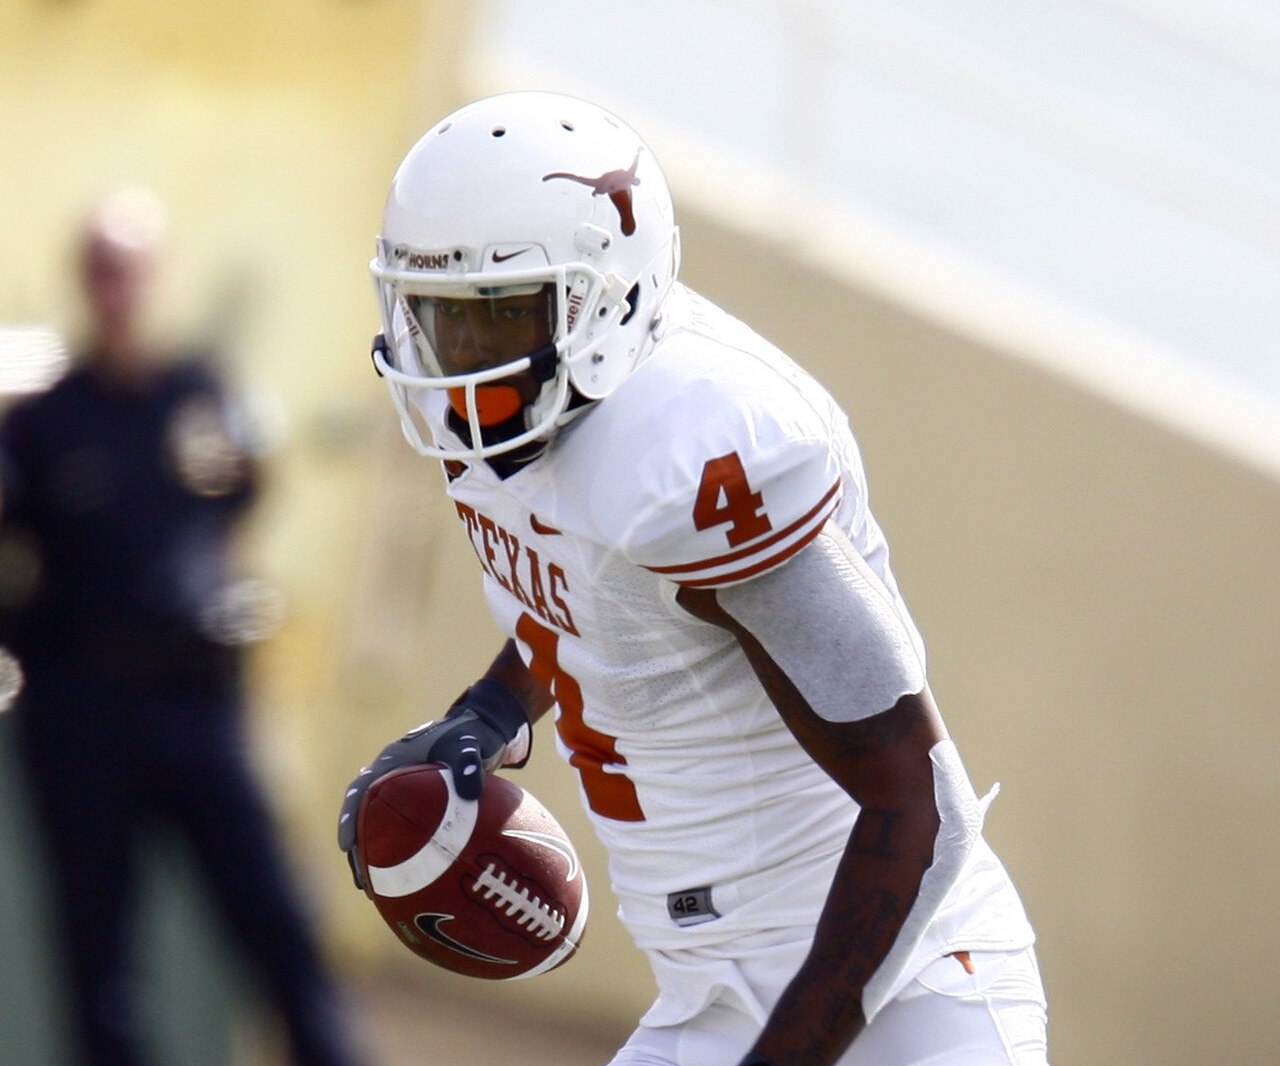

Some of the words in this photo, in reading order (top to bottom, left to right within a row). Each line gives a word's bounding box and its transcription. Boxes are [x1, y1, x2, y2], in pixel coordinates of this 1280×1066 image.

[408, 253, 449, 269] HORNS
[692, 451, 773, 549] 4
[455, 500, 581, 638] TEXAS
[673, 896, 700, 913] 42
